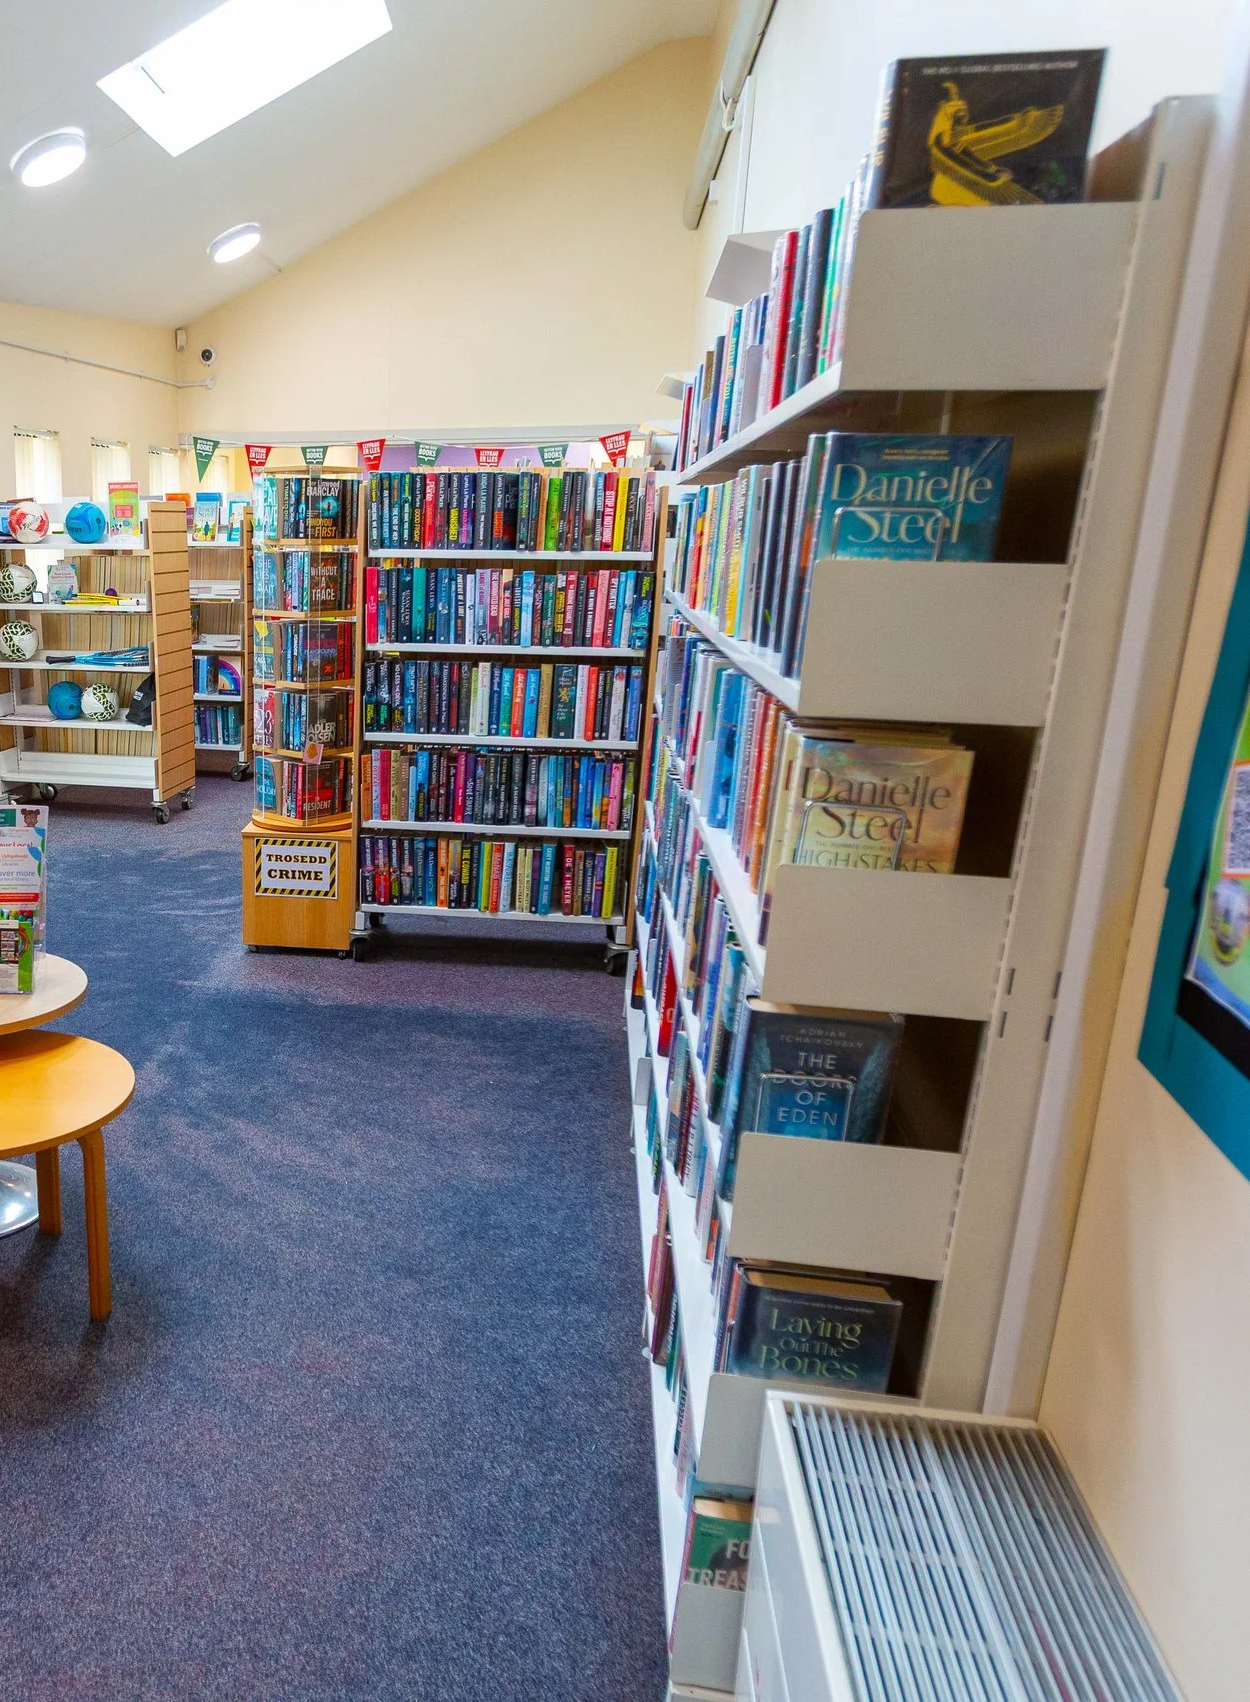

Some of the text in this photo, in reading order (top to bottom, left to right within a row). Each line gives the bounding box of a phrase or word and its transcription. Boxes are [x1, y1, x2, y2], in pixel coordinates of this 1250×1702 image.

[197, 443, 213, 452] BOOKS
[418, 448, 436, 457] BOOKS
[306, 451, 323, 459] BOOKS
[544, 451, 562, 459] BOOKS
[831, 463, 993, 504] Danielle
[307, 486, 339, 496] BARCLAY
[605, 491, 615, 507] STOP
[321, 518, 332, 527] YOU
[449, 508, 458, 540] VANISHED
[602, 516, 613, 543] NOTHING
[847, 502, 964, 544] Steel
[315, 527, 337, 537] FIRST
[311, 566, 337, 576] WITHOUT
[312, 589, 335, 601] TRACE
[309, 722, 336, 735] ADLER
[802, 767, 951, 810] Danielle
[303, 801, 331, 811] RESIDENT
[817, 806, 925, 844] Steel
[266, 854, 327, 864] TROSEDD
[859, 851, 938, 873] STAKES
[461, 849, 471, 884] THE COWARD
[16, 870, 36, 878] more
[267, 869, 323, 881] CRIME
[564, 880, 572, 904] MEYER
[800, 1028, 847, 1038] ADRIAN
[780, 1035, 864, 1048] TCHAIKOVSKY
[798, 1052, 838, 1070] THE
[796, 1091, 827, 1106] OF
[777, 1106, 838, 1126] EDEN
[771, 1309, 864, 1349] Laying
[780, 1337, 844, 1357] Out The
[759, 1345, 859, 1380] Bones
